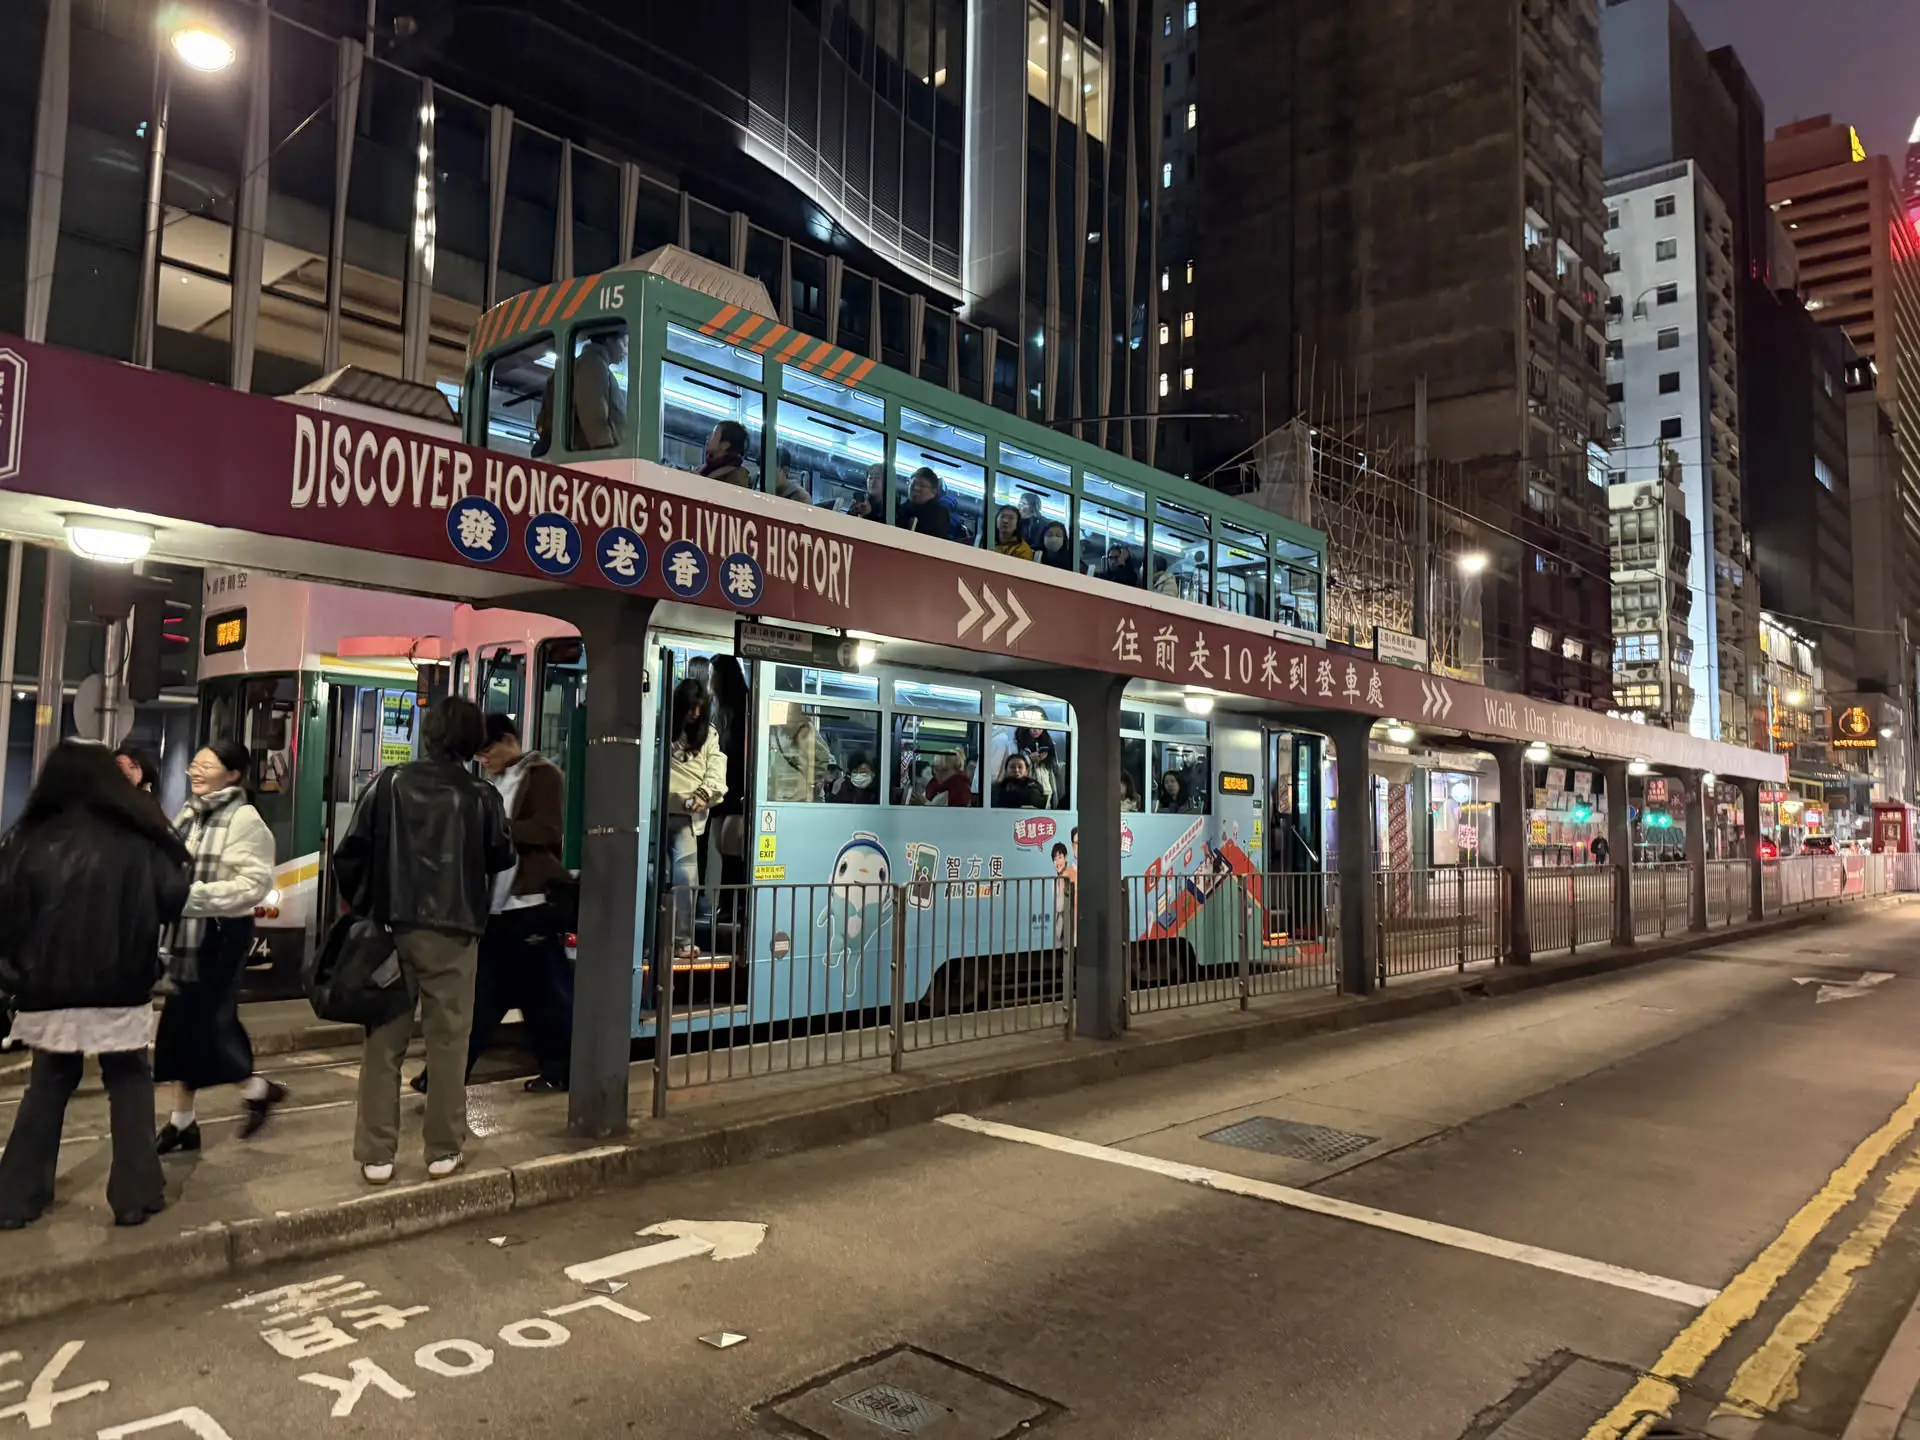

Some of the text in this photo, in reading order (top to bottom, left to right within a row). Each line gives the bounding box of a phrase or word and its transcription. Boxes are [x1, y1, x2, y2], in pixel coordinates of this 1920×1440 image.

[600, 285, 625, 310] 115
[290, 413, 854, 609] DISCOVER HONGKONG'S LIVING HISTORY
[457, 507, 757, 599] 發現老香港
[1112, 617, 1384, 709] 往前走10米到登車處
[1485, 698, 1517, 730] Walk
[1524, 706, 1547, 736] 10m
[1552, 713, 1586, 743] further
[1592, 725, 1602, 746] to
[759, 850, 774, 858] EXIT
[946, 855, 1002, 879] 智方便
[298, 1296, 652, 1417] LOOK
